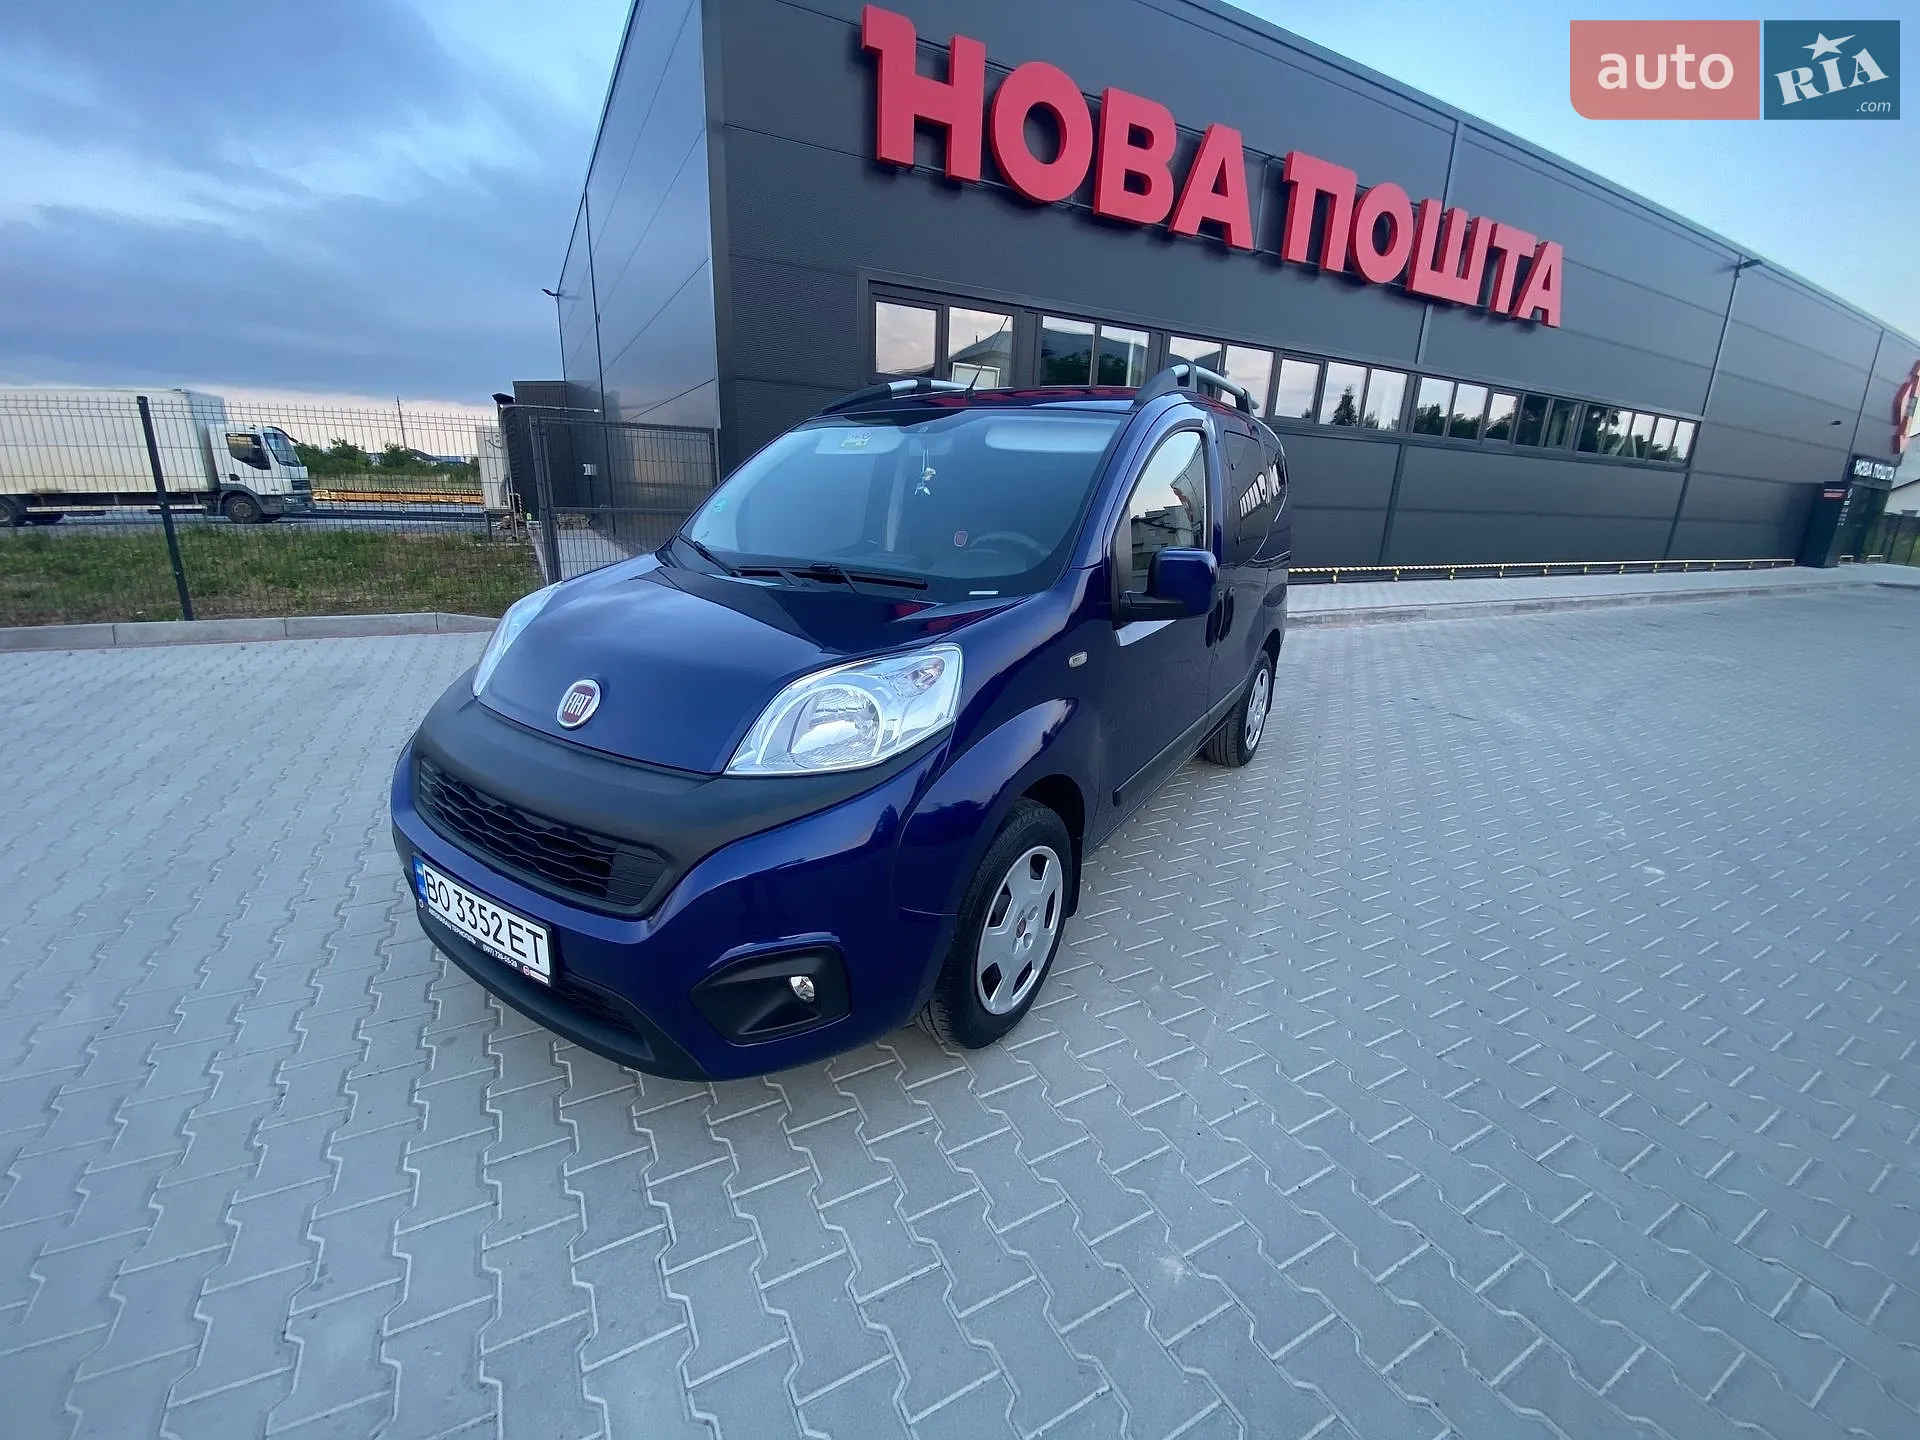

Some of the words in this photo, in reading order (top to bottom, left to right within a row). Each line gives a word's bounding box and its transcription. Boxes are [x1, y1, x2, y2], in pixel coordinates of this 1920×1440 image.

[861, 4, 1254, 250] НОВА
[1281, 150, 1563, 328] ПОШТА
[564, 691, 592, 716] FIAT
